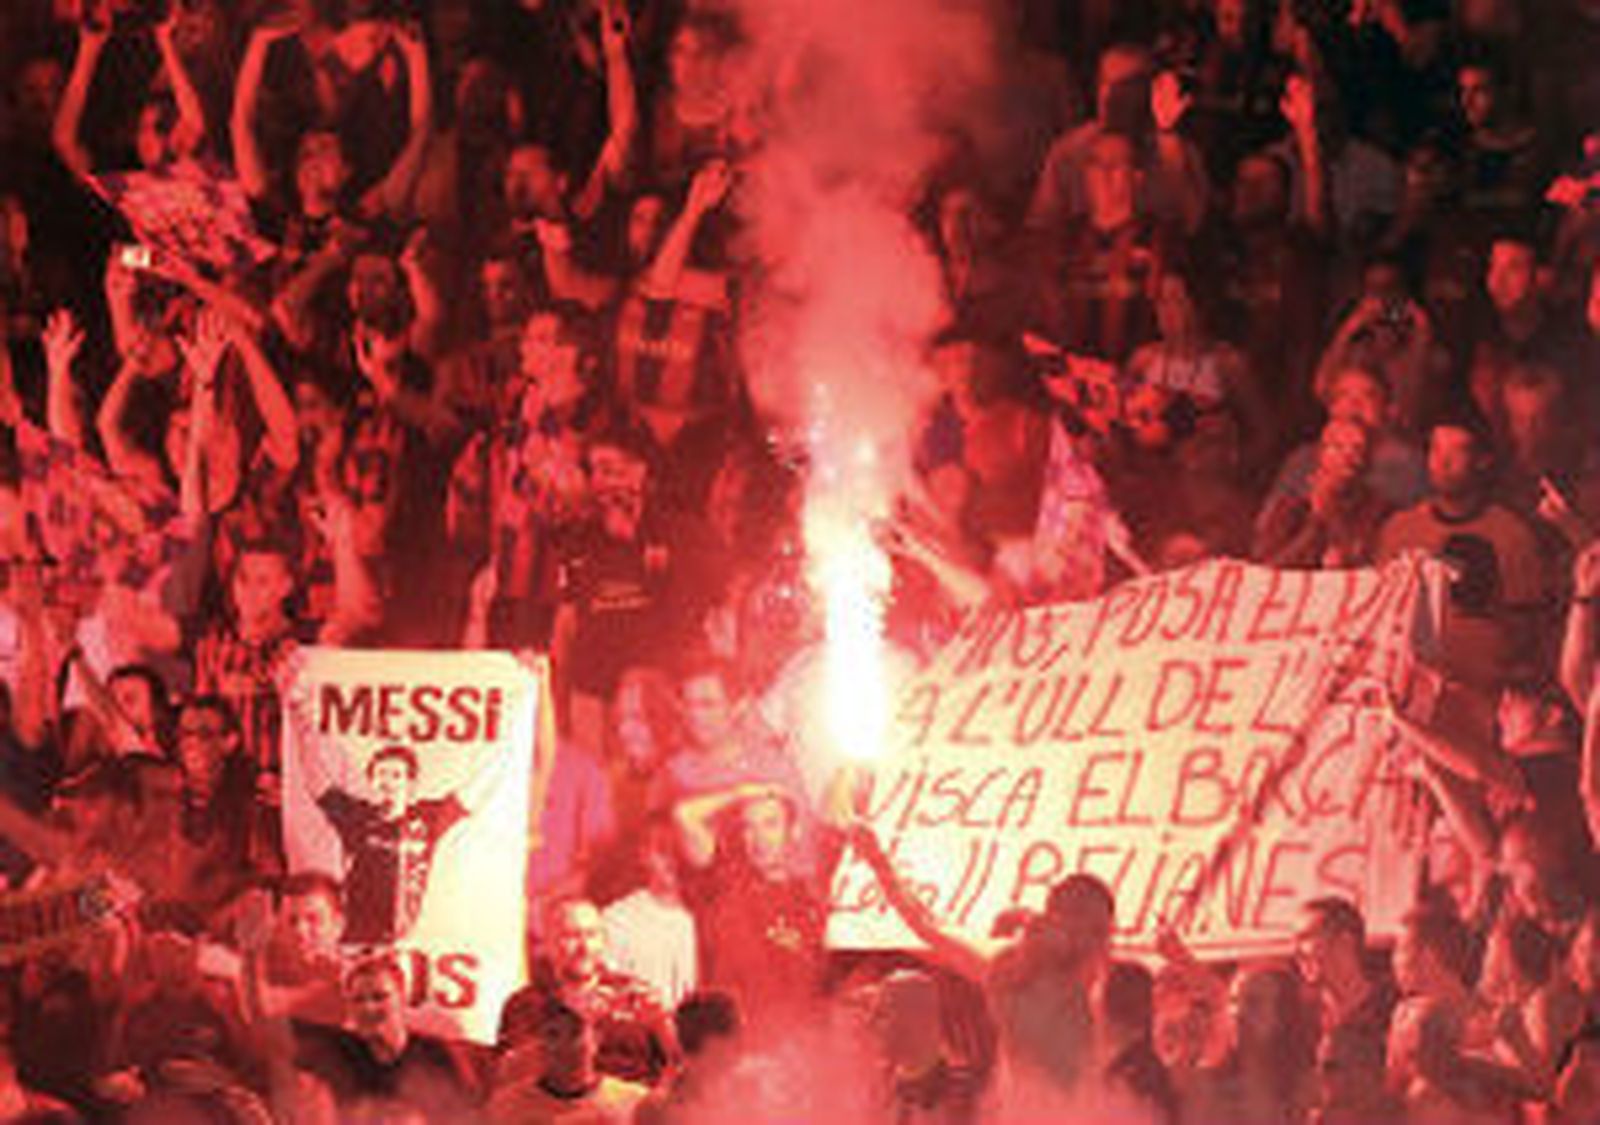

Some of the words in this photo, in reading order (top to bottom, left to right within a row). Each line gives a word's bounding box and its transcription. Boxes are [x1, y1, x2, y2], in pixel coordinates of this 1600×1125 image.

[1083, 562, 1245, 658] POSA
[1146, 656, 1247, 734] DE
[1066, 746, 1154, 828] EL
